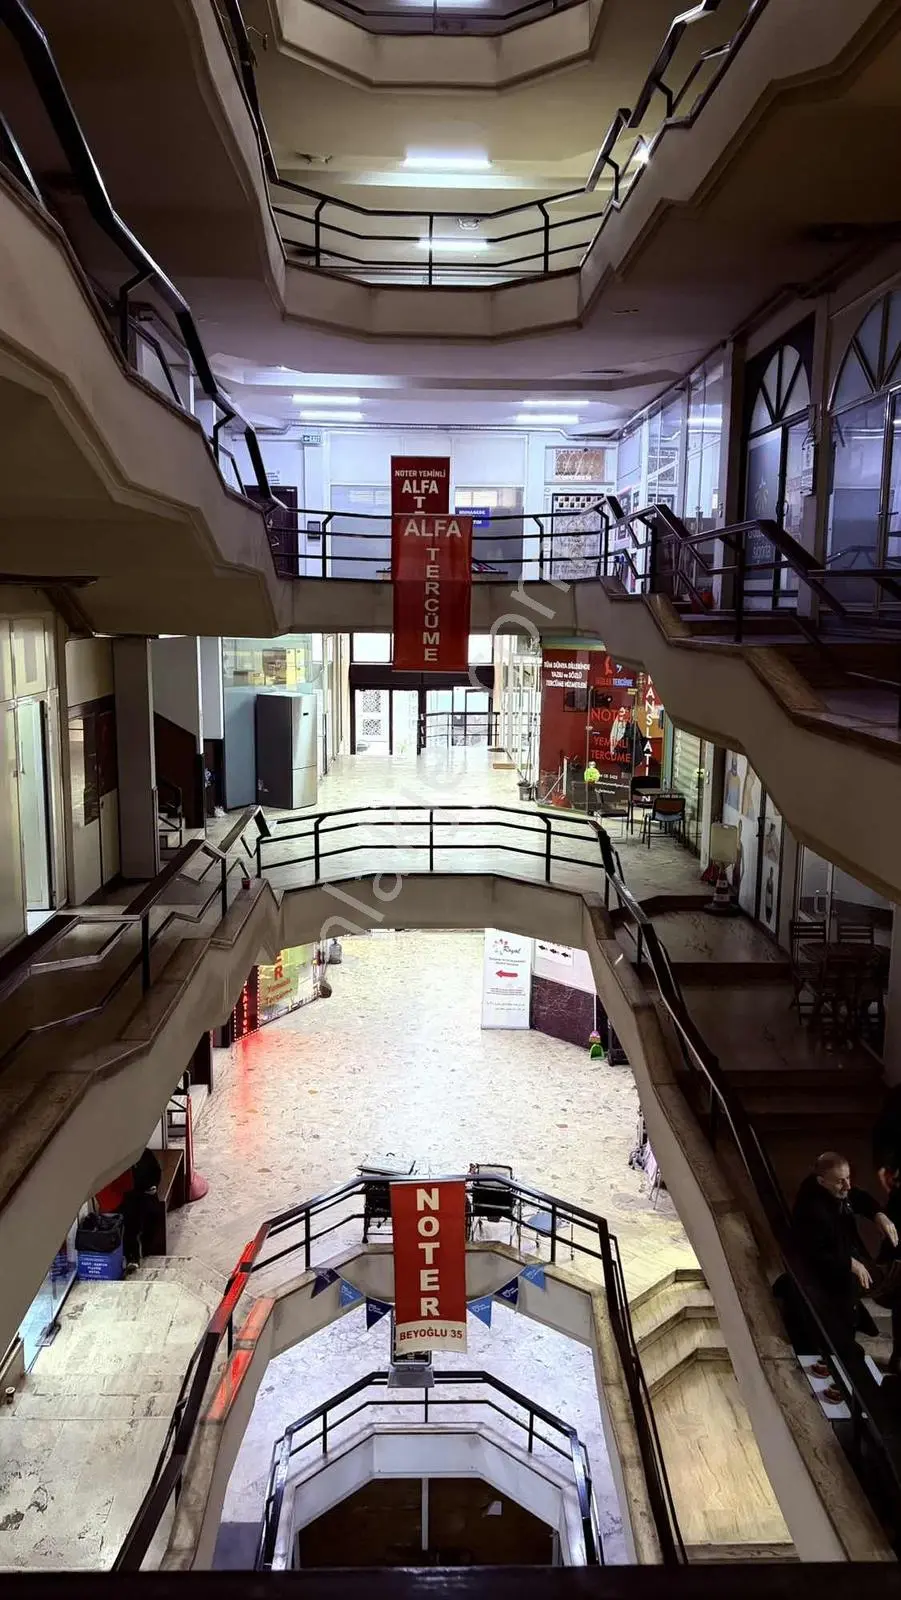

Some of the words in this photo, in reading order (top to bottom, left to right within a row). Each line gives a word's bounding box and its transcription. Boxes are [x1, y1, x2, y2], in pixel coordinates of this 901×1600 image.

[419, 469, 446, 478] YEMİNLİ
[401, 480, 439, 494] ALFA
[404, 519, 462, 537] ALFA
[423, 548, 440, 661] TERCÜME
[416, 1188, 440, 1317] NOTER
[400, 1326, 447, 1341] BEYOĞLU
[450, 1330, 463, 1339] 35
